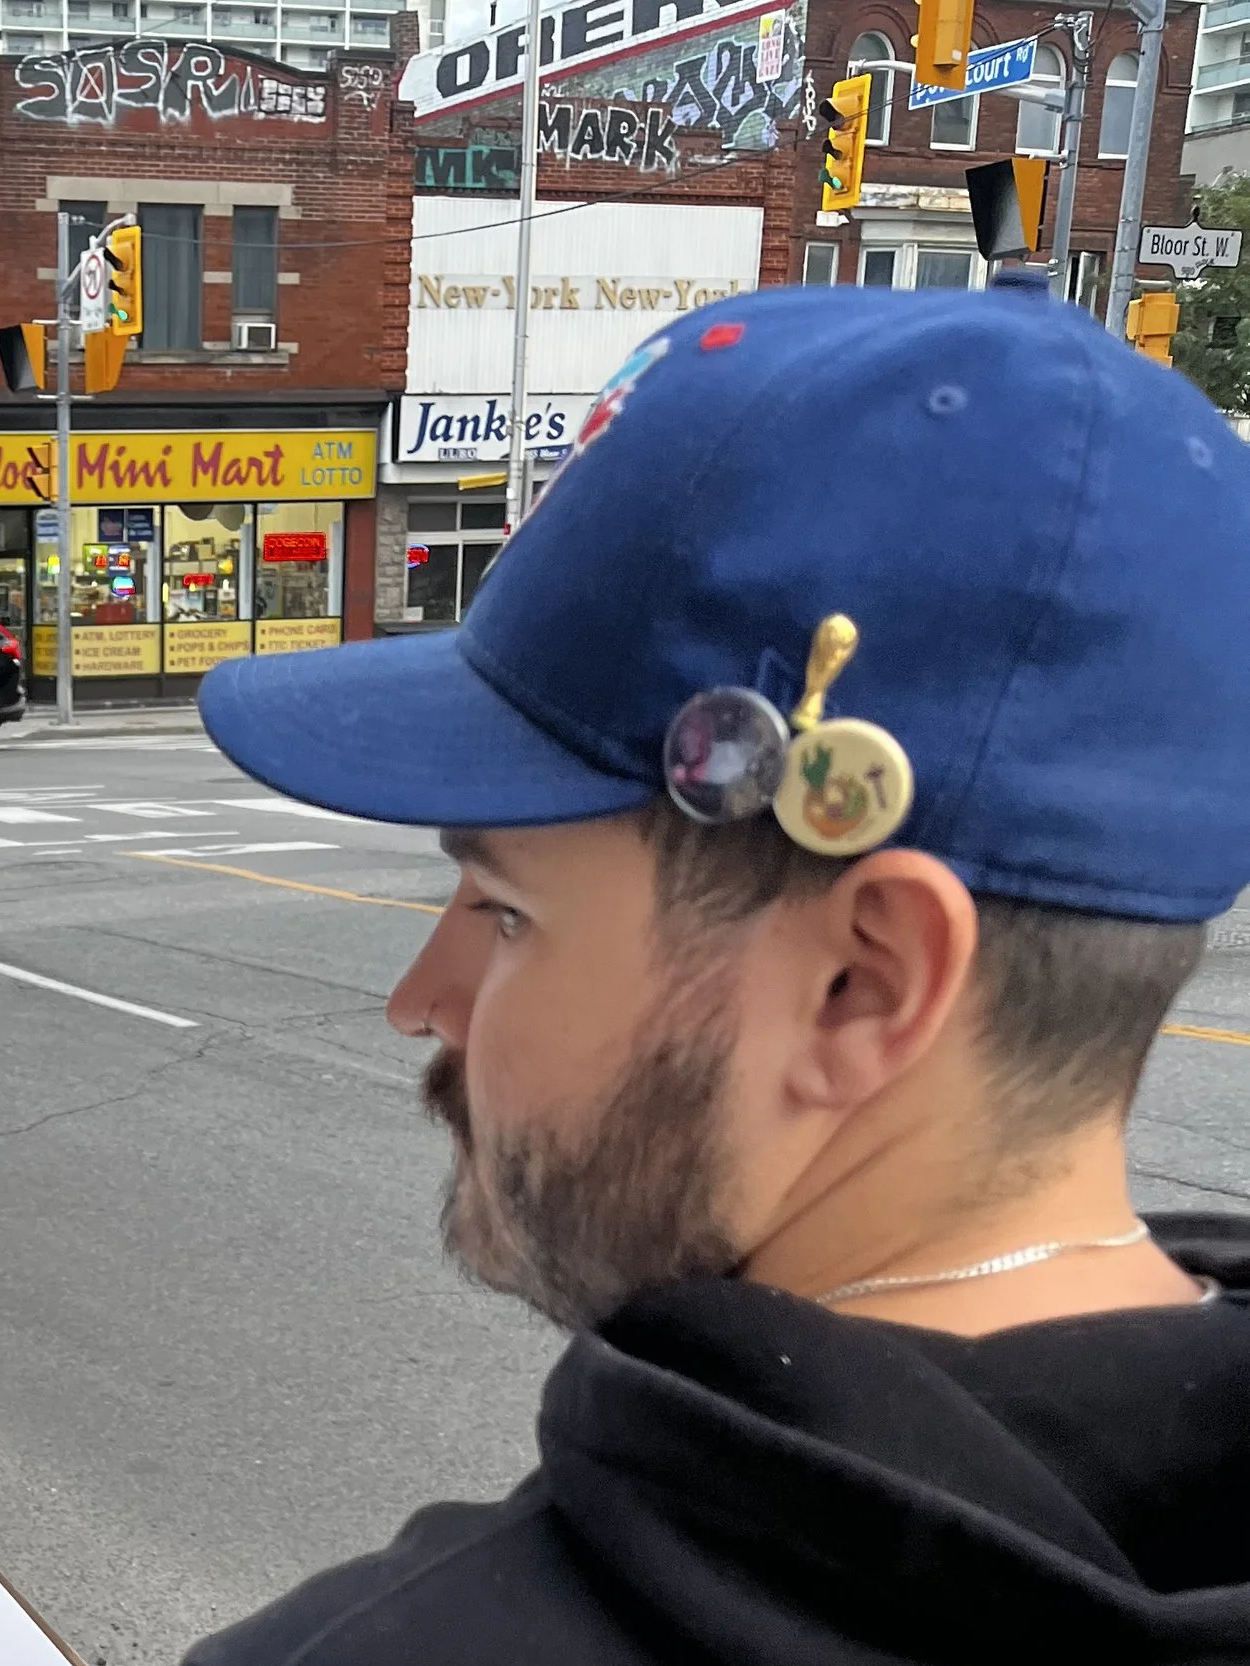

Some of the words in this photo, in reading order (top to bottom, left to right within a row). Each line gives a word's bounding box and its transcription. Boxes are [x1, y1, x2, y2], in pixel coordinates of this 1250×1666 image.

[1016, 48, 1028, 62] Rd
[1151, 234, 1190, 255] Bloor
[1192, 236, 1210, 257] St.
[1216, 237, 1230, 257] W.
[406, 399, 566, 454] Janke's
[312, 442, 353, 460] ATM
[77, 442, 173, 489] Mini
[191, 441, 285, 487] Mart
[301, 467, 363, 486] LOTTO
[109, 630, 155, 641] LOTTERY
[177, 629, 227, 640] GROCERY
[102, 647, 142, 657] CREAM
[176, 642, 205, 652] POPS
[217, 641, 250, 651] CHIPS
[81, 660, 143, 671] HARDWARE
